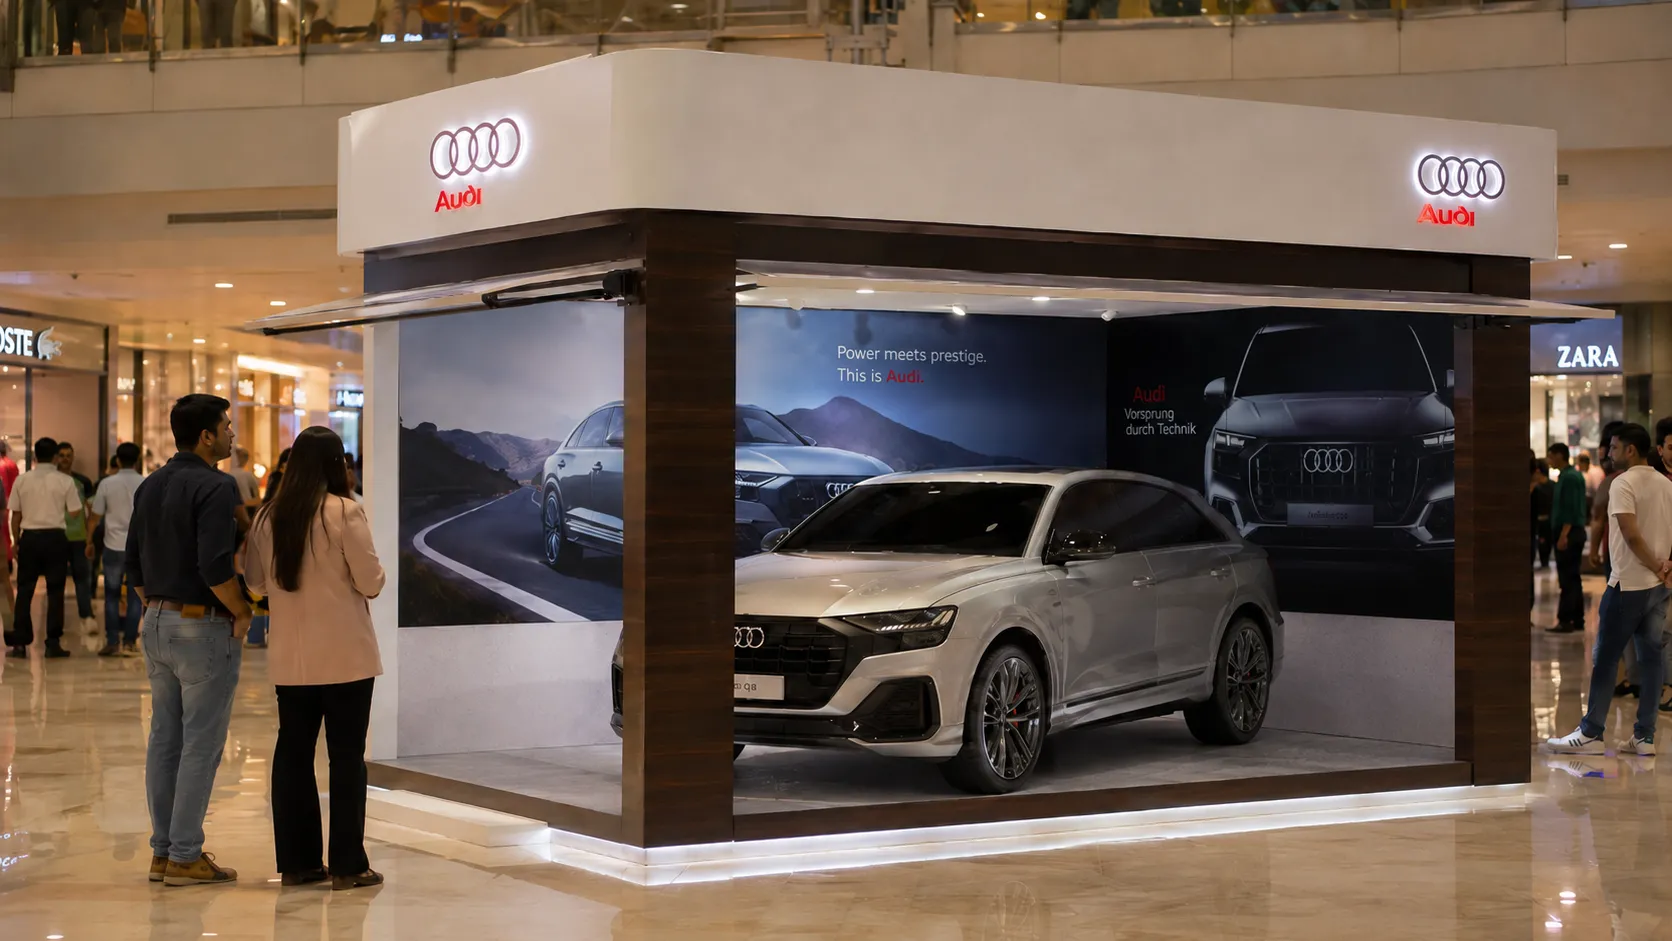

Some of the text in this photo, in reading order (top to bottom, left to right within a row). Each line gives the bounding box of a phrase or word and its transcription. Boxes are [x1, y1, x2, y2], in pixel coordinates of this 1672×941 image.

[434, 185, 482, 212] Audi
[1417, 203, 1475, 227] Audi
[837, 345, 987, 366] Power meets prestige.
[1557, 344, 1619, 368] ZARA
[837, 367, 924, 384] This is Audi.
[1133, 384, 1166, 402] Audi
[1124, 408, 1175, 422] Vorsprung
[1125, 422, 1197, 435] durch Technik
